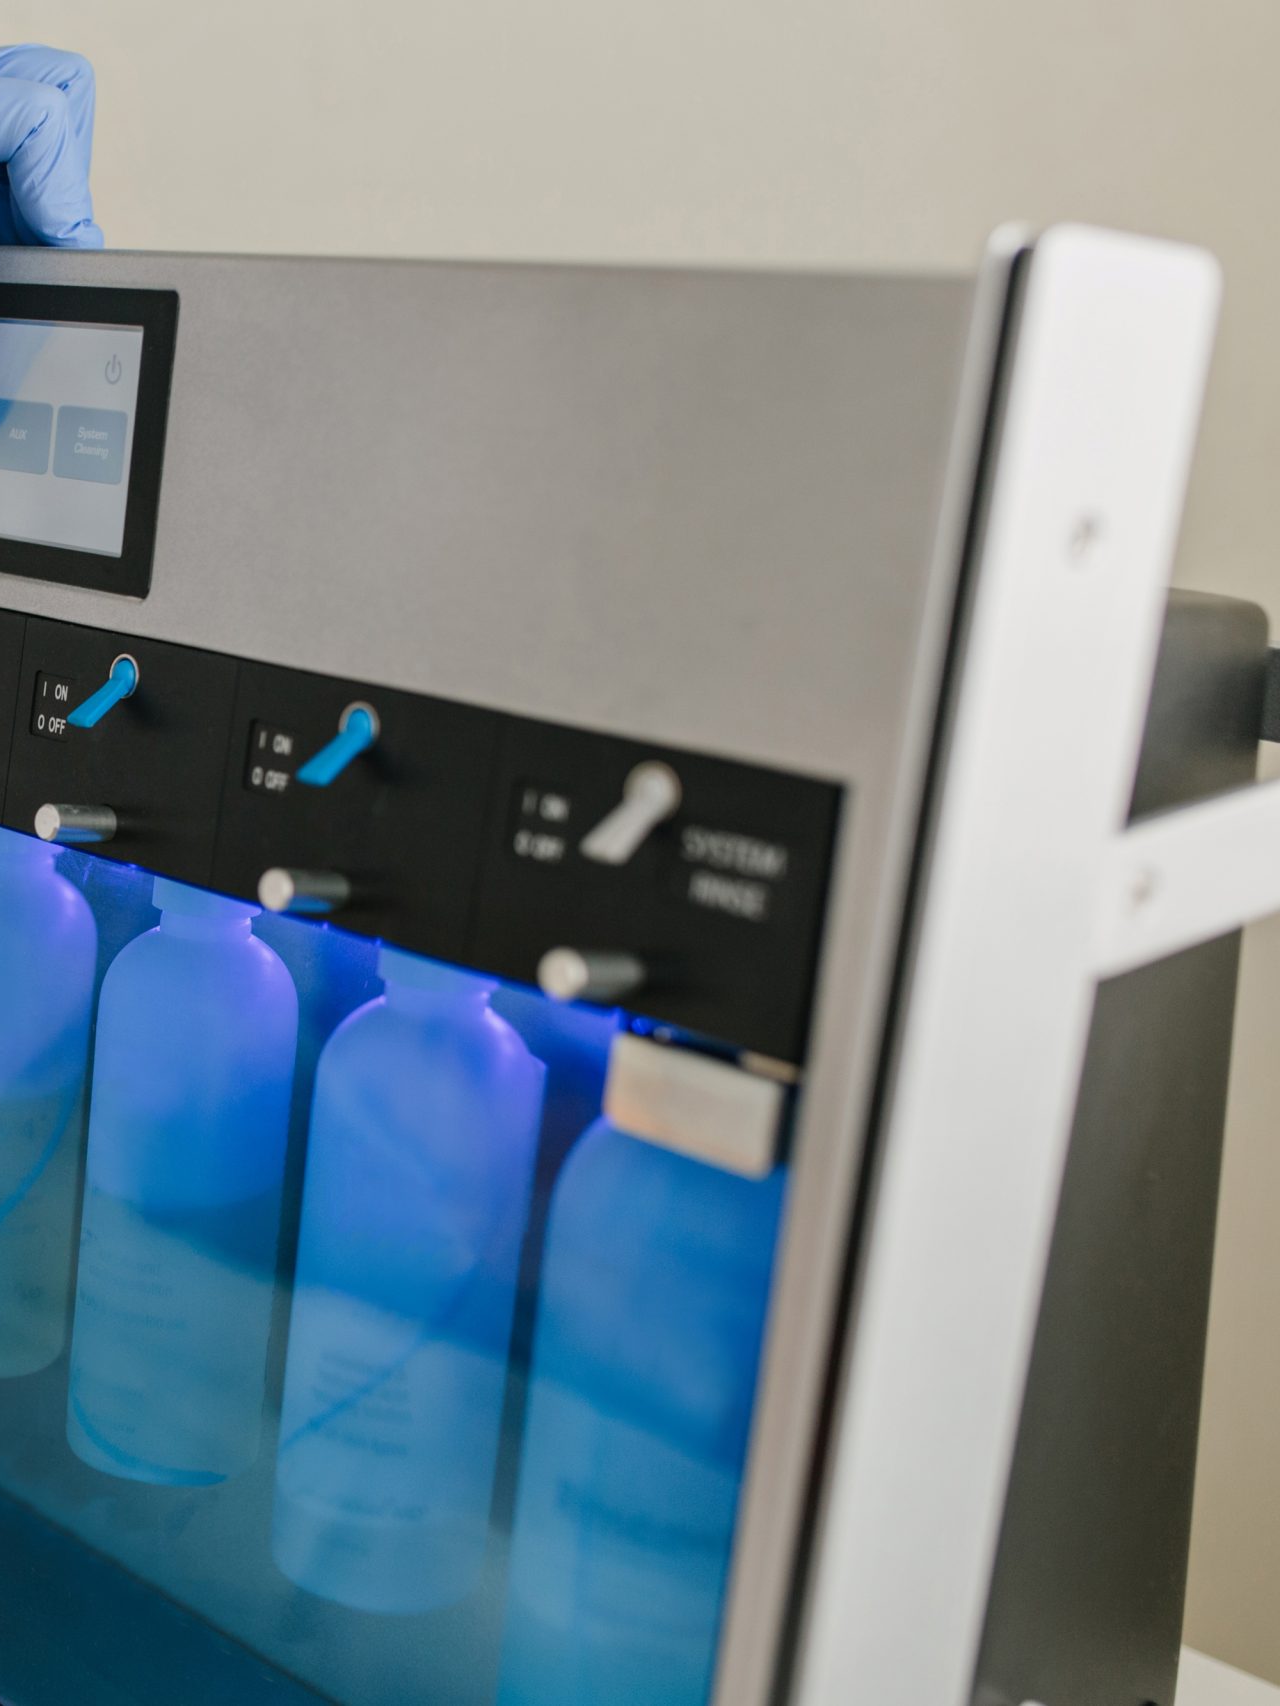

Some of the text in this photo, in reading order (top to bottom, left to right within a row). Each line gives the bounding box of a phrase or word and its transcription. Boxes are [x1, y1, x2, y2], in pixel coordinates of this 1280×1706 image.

[9, 427, 28, 440] AUX
[77, 426, 108, 441] System
[73, 442, 109, 460] Cleaning
[54, 684, 69, 702] ON
[48, 716, 66, 735] OFF
[272, 734, 293, 756] ON
[264, 769, 289, 792] OFF
[681, 825, 788, 878] SYSTEM
[688, 870, 767, 920] RINSE
